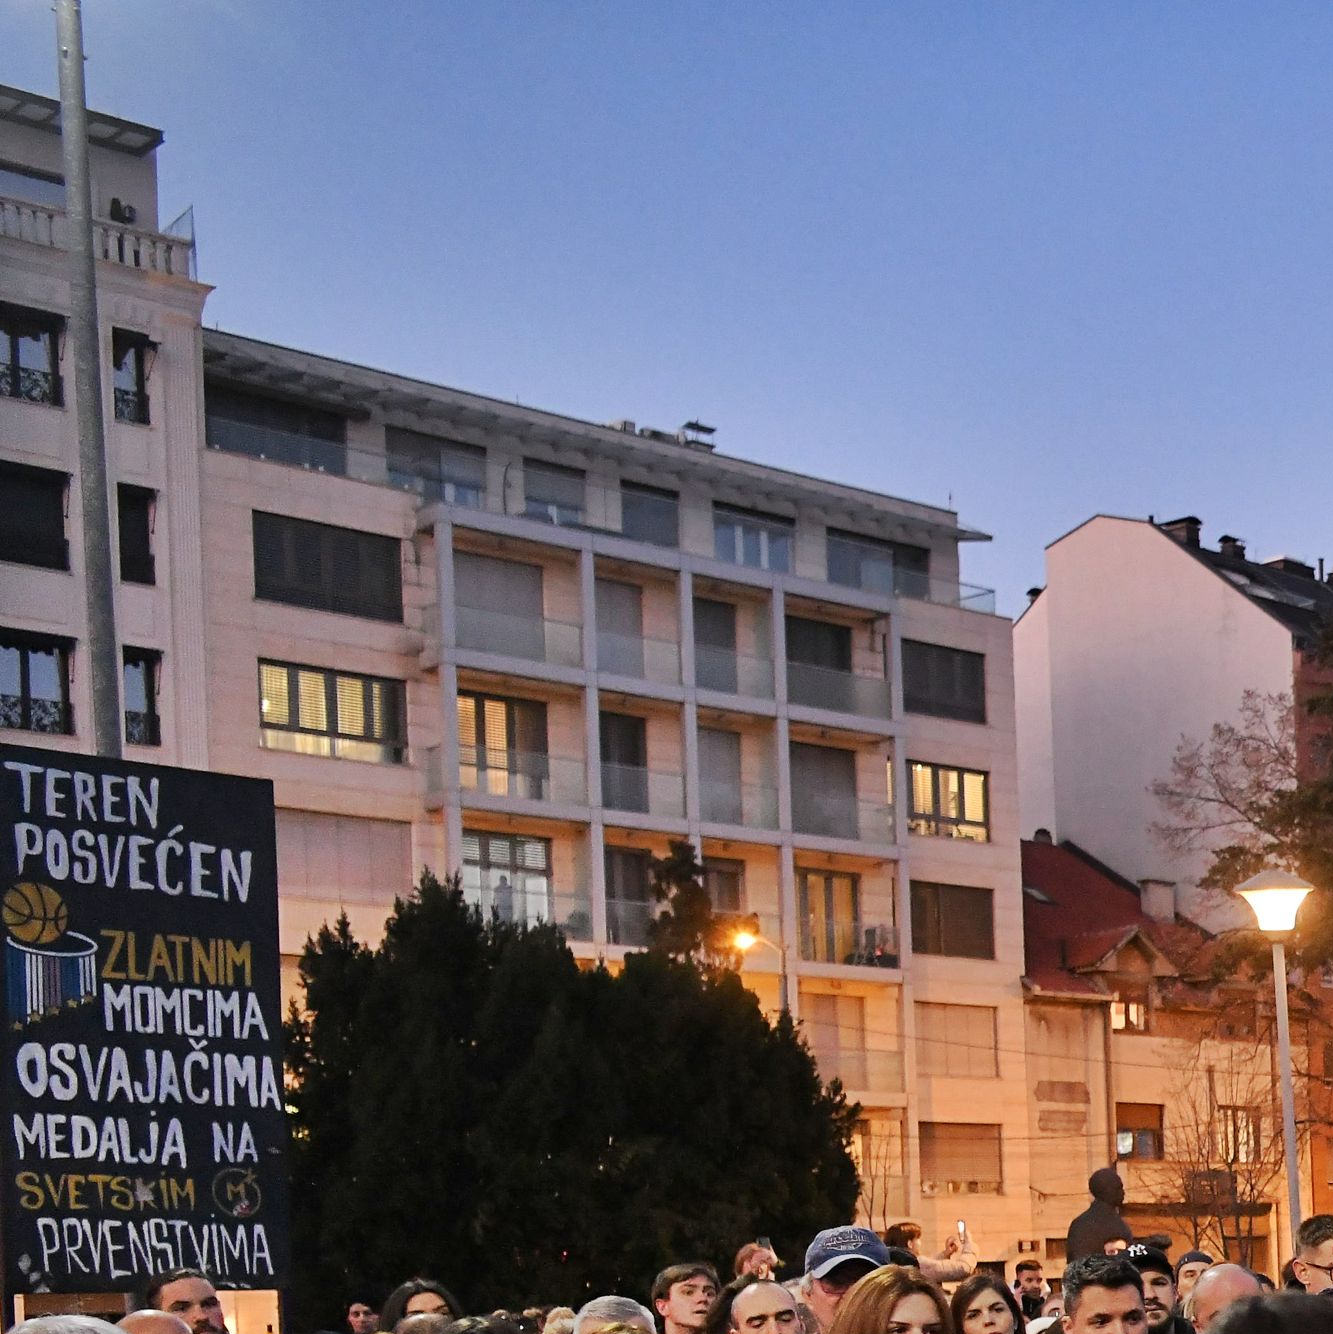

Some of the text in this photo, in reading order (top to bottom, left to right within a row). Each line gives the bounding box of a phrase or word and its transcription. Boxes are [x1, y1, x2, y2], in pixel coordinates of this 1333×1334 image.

[3, 760, 160, 829] TEREN
[15, 822, 253, 903] POSVEĆEN
[100, 928, 253, 986] ZLATNIM
[16, 1037, 282, 1111] OSVAJAČIMA
[13, 1110, 259, 1168] MEDALJA NA
